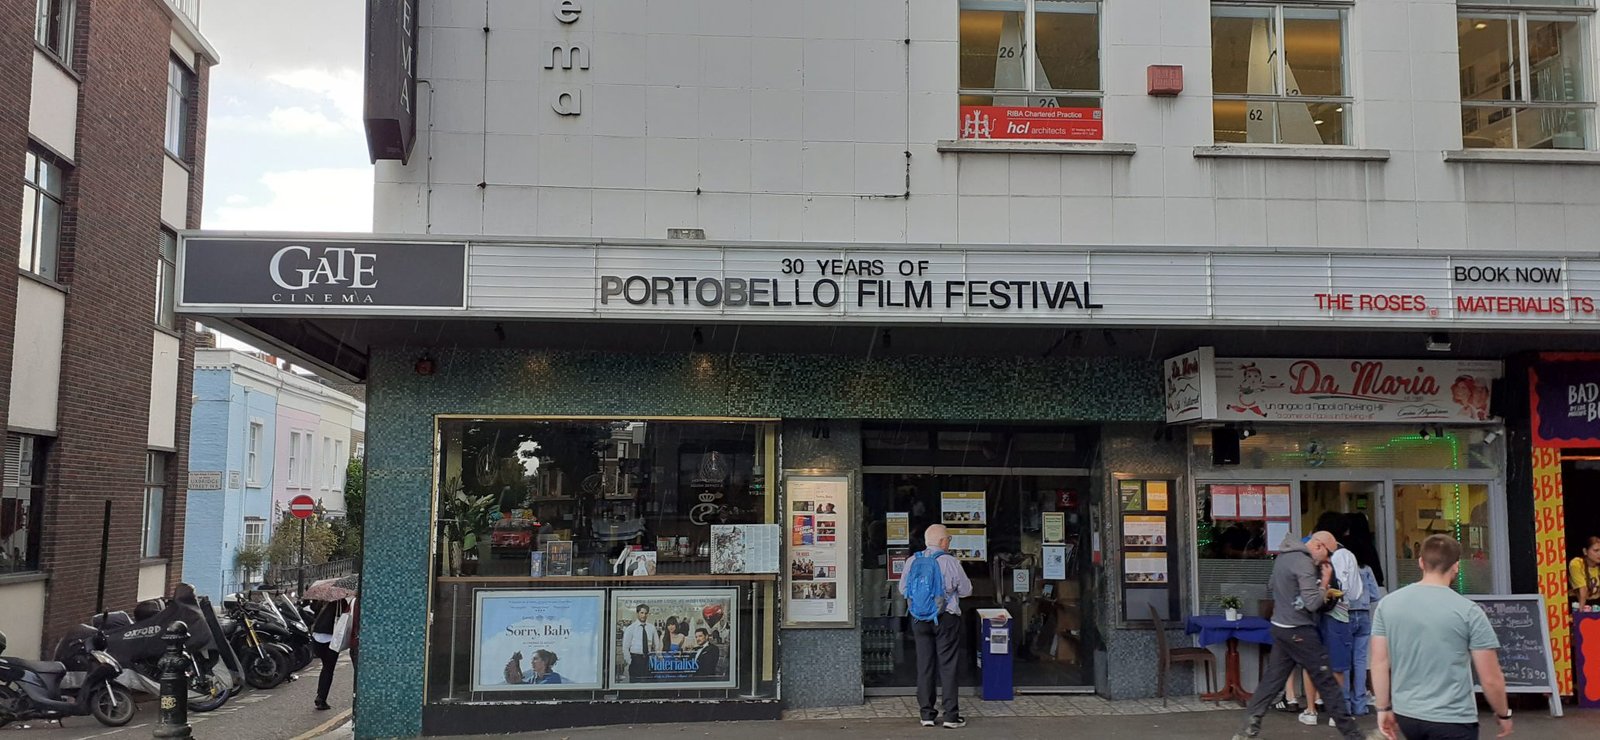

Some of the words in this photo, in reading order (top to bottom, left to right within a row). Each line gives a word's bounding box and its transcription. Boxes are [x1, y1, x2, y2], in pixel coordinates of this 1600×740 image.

[999, 46, 1015, 58] 26
[1006, 110, 1024, 118] RIBA
[1025, 110, 1056, 118] Chartered
[1057, 111, 1082, 119] Practice
[1249, 108, 1263, 121] 62
[1007, 121, 1030, 134] hcl
[1031, 126, 1066, 135] architects
[269, 245, 379, 290] GATE
[781, 258, 805, 275] 30
[817, 259, 884, 276] YEARS
[898, 260, 930, 276] OF
[1454, 266, 1510, 282] BOOK
[1515, 267, 1562, 283] NOW
[272, 292, 374, 303] CINEMA
[600, 275, 840, 308] PORTOBELLO
[857, 279, 933, 308] FILM
[945, 280, 1103, 310] FESTIVAL
[1314, 293, 1354, 311] THE
[1359, 294, 1426, 312] ROSES
[1288, 360, 1340, 395] Da
[1351, 361, 1440, 396] Maria
[1568, 382, 1600, 406] BAD
[123, 625, 161, 638] OXFORD
[505, 624, 541, 640] Sorry,
[544, 624, 571, 640] Baby
[648, 655, 700, 671] Materialists
